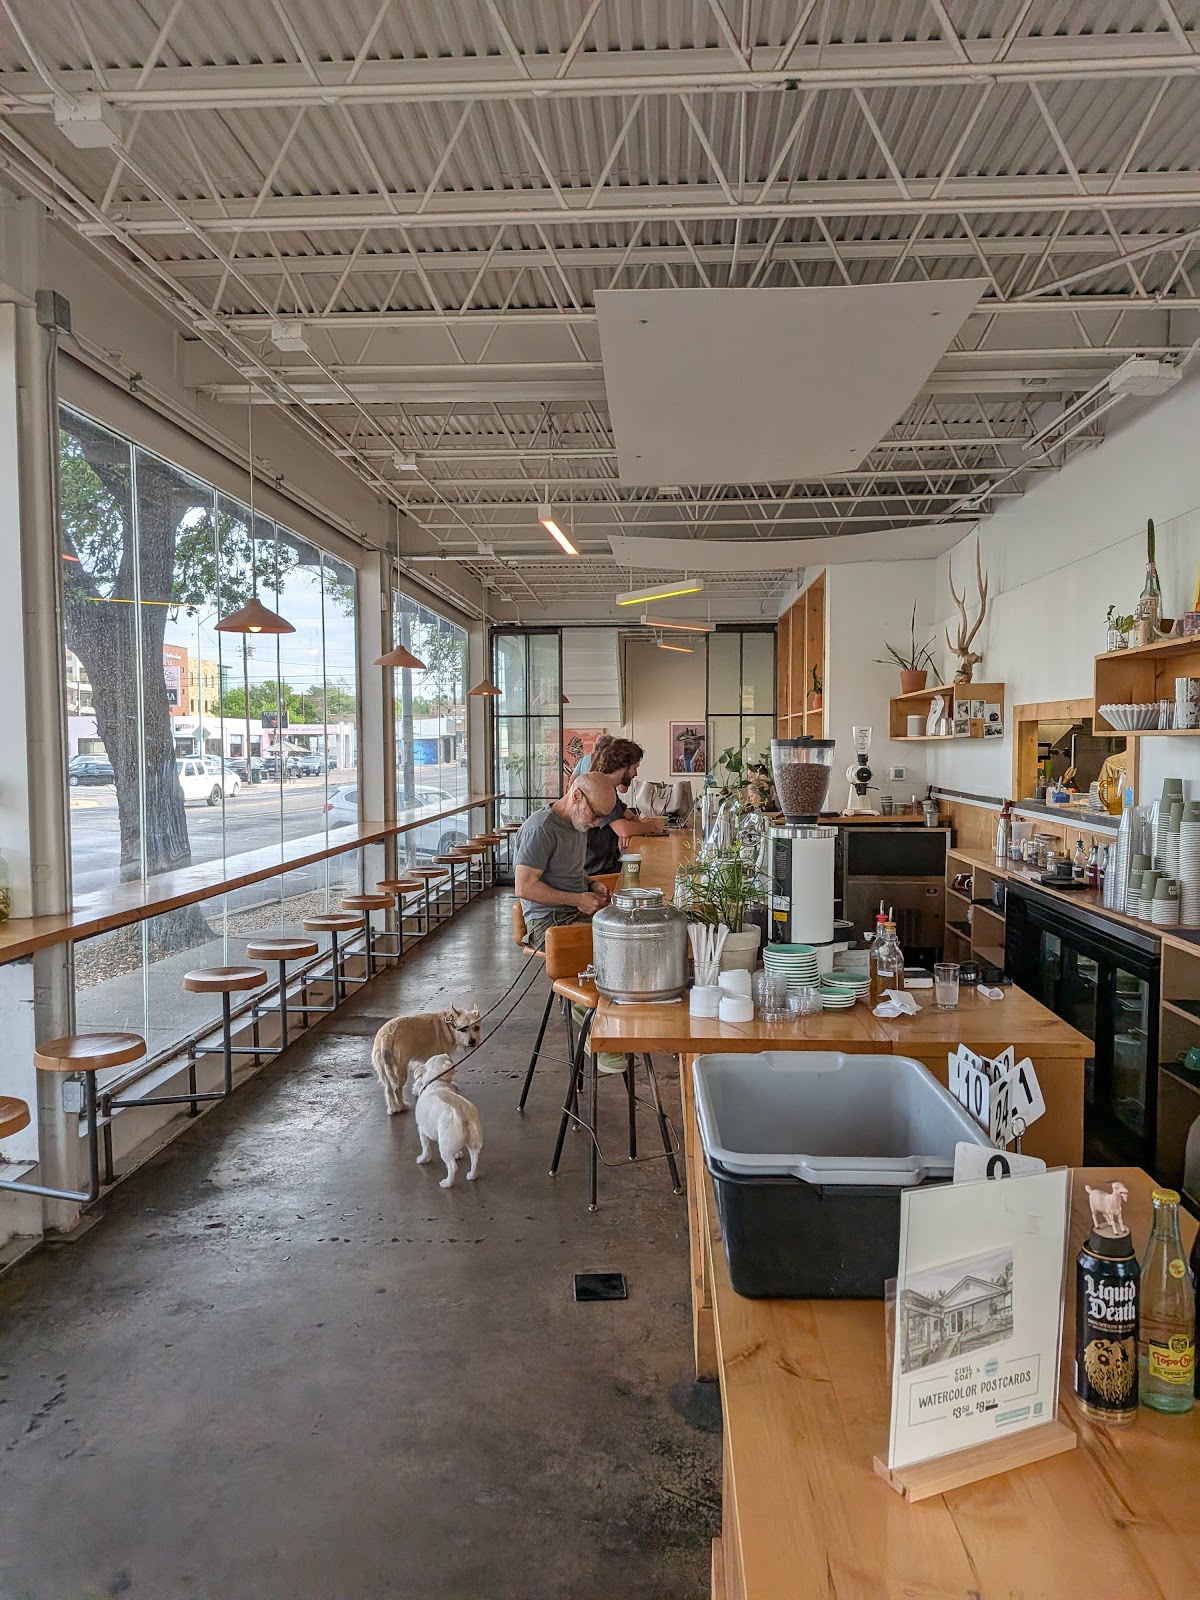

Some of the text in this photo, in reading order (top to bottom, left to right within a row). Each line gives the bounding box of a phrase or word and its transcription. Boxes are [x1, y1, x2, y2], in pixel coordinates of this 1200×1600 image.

[964, 1069, 983, 1117] 10
[995, 1088, 1010, 1143] 24
[1084, 1274, 1136, 1307] Liquid
[1088, 1296, 1136, 1322] Death
[954, 1365, 973, 1375] CIVIL
[1152, 1352, 1180, 1367] Topo
[918, 1370, 1032, 1409] WATERCOLOR POSTCARDS
[954, 1371, 973, 1382] GOAT
